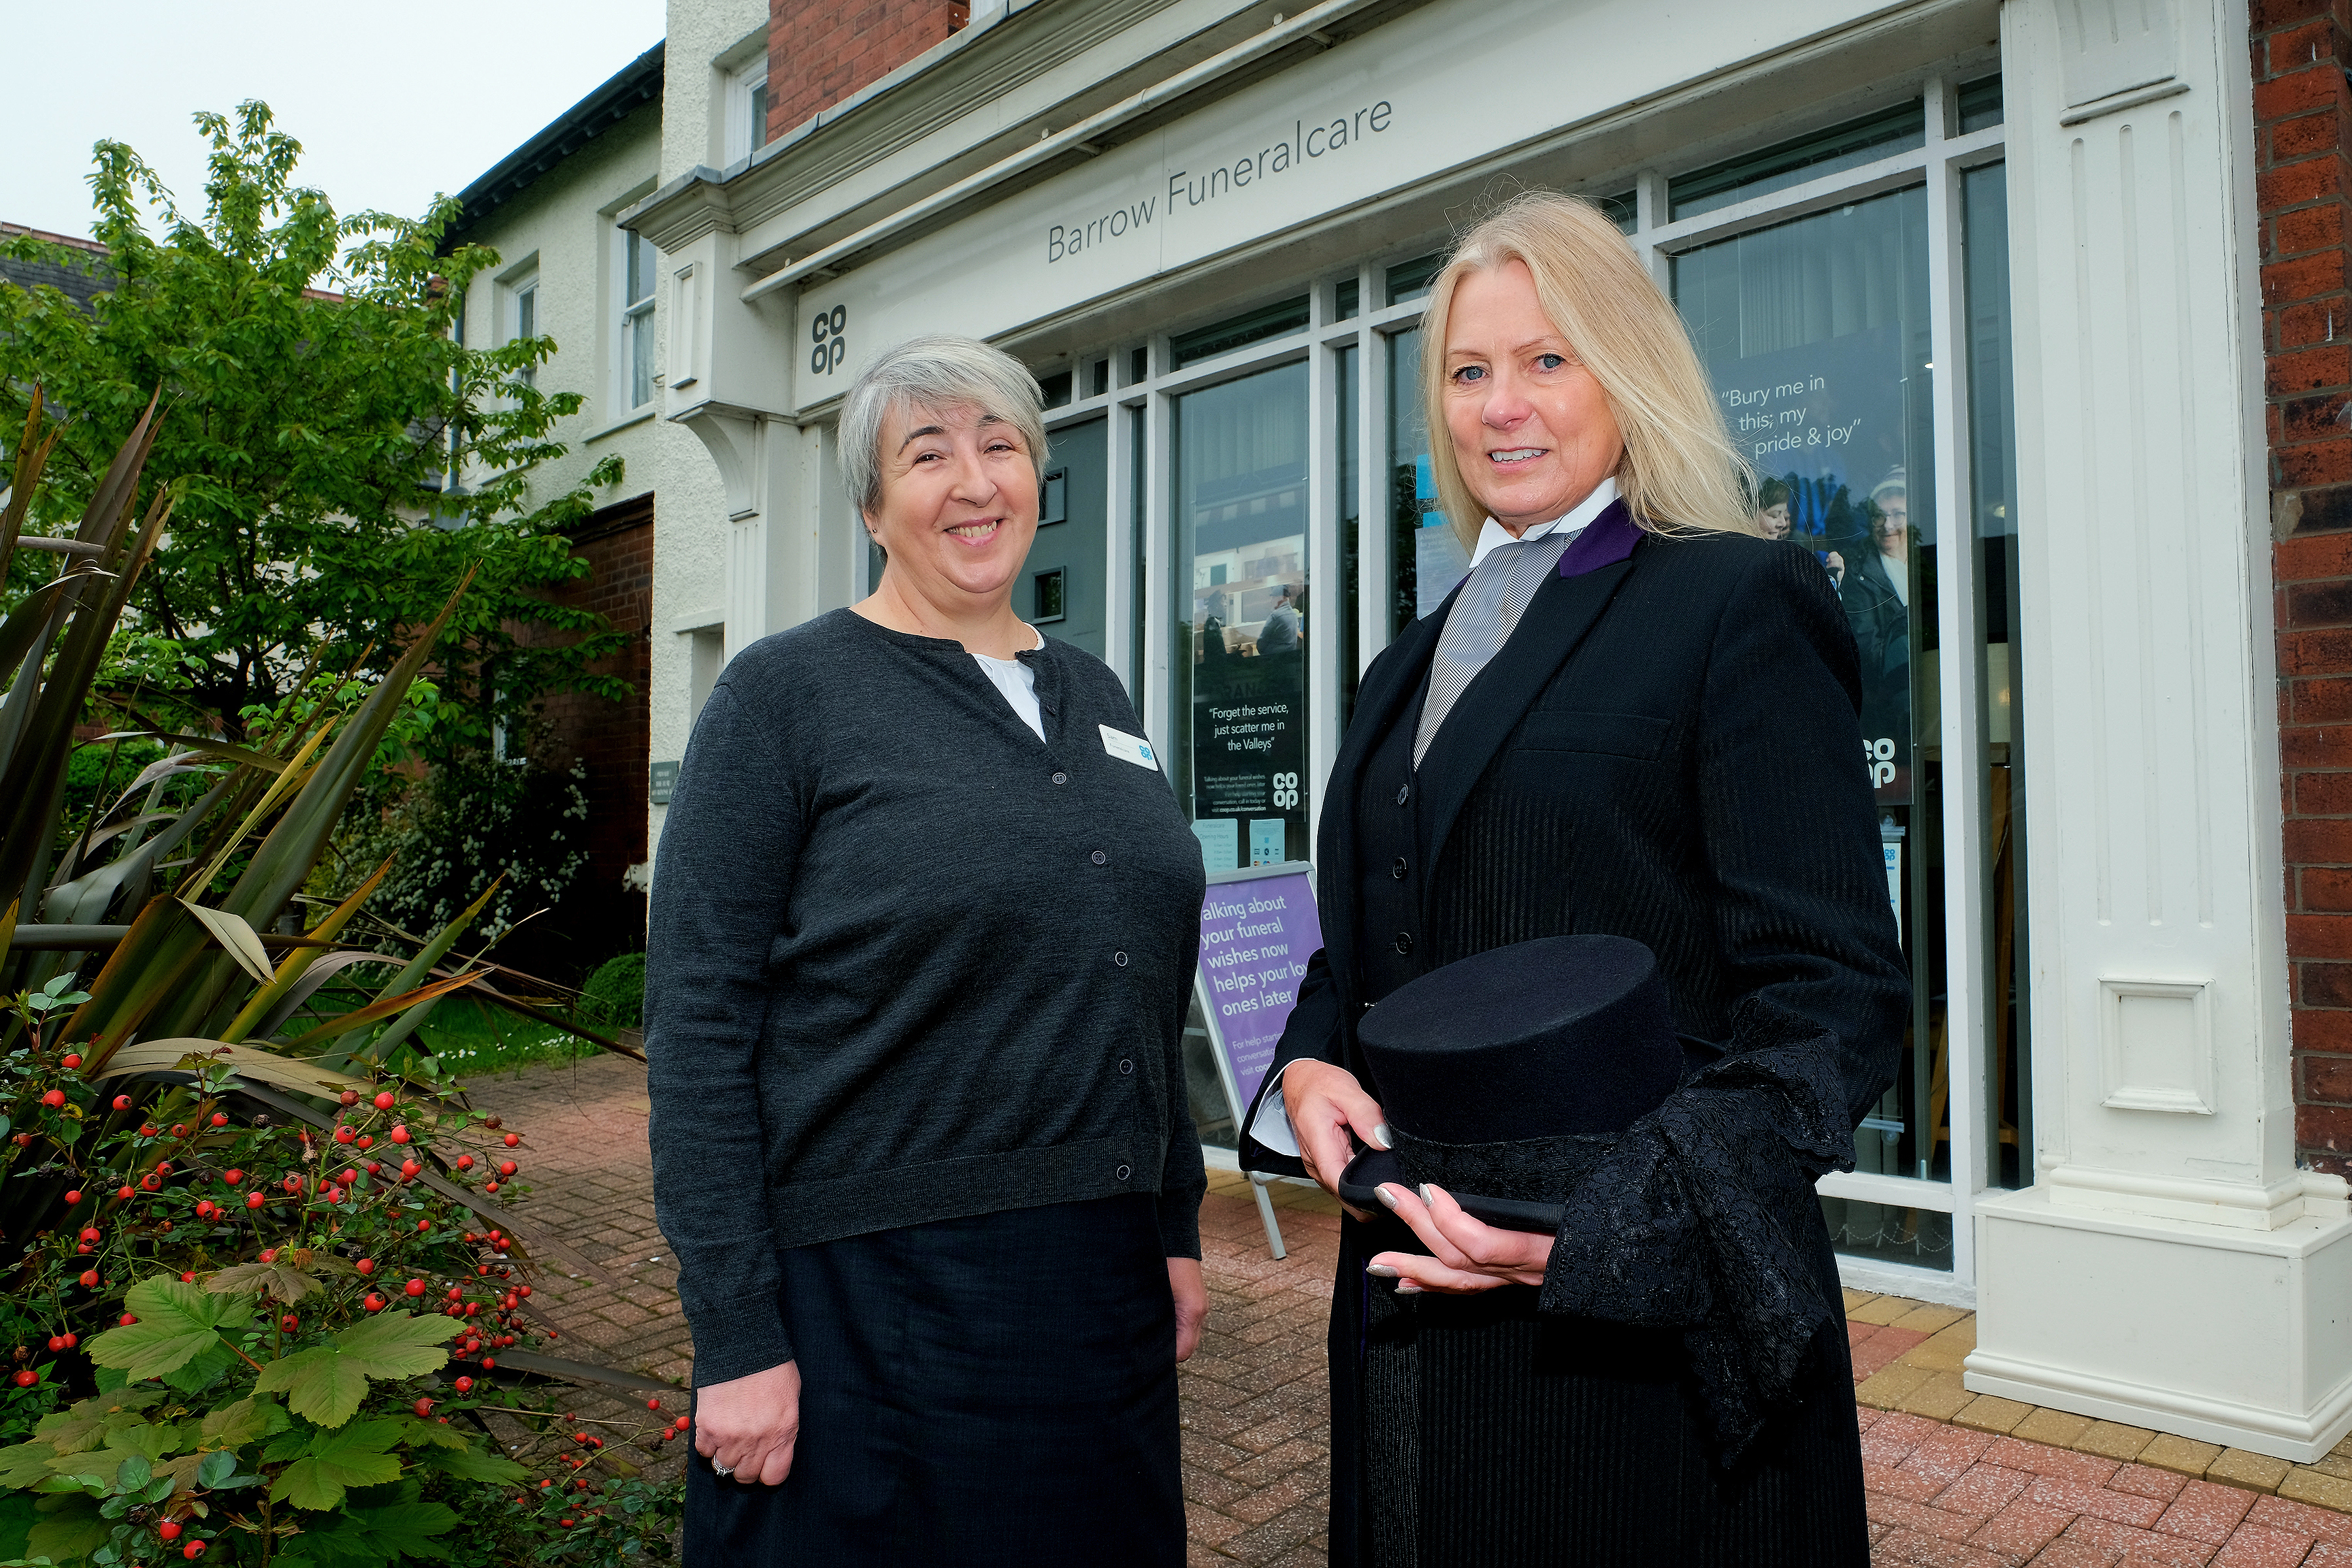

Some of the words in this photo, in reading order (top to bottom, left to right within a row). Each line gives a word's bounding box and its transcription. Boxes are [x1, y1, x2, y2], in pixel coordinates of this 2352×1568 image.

[1048, 196, 1156, 264] Barrow
[1168, 101, 1392, 215] Funeralcare
[1722, 388, 1771, 406] “Bury
[1776, 382, 1803, 398] me
[1810, 374, 1824, 391] in
[1780, 408, 1806, 426] my
[1755, 431, 1802, 460] pride
[1807, 427, 1821, 446] &
[1825, 418, 1861, 448] joy”
[1209, 707, 1240, 721] “Forget
[1241, 704, 1256, 716] the
[1257, 702, 1288, 715] service,
[1214, 725, 1230, 738] just
[1231, 723, 1260, 734] scatter
[1261, 723, 1275, 731] me
[1277, 719, 1284, 730] in
[1228, 740, 1241, 751] the
[1243, 736, 1275, 751] Valleys”
[1202, 902, 1247, 919] alking
[1248, 896, 1287, 913] about
[1201, 928, 1234, 950] your
[1237, 916, 1284, 938] funeral
[1207, 947, 1259, 968] wishes
[1261, 943, 1288, 958] now
[1213, 972, 1256, 993] helps
[1258, 967, 1288, 988] your
[1288, 960, 1307, 977] lov
[1222, 998, 1259, 1016] ones
[1260, 990, 1292, 1007] later
[1232, 1041, 1244, 1049] For
[1245, 1036, 1262, 1047] help
[1262, 1032, 1282, 1043] startin
[1237, 1047, 1274, 1063] conversatio
[1241, 1066, 1254, 1075] visit
